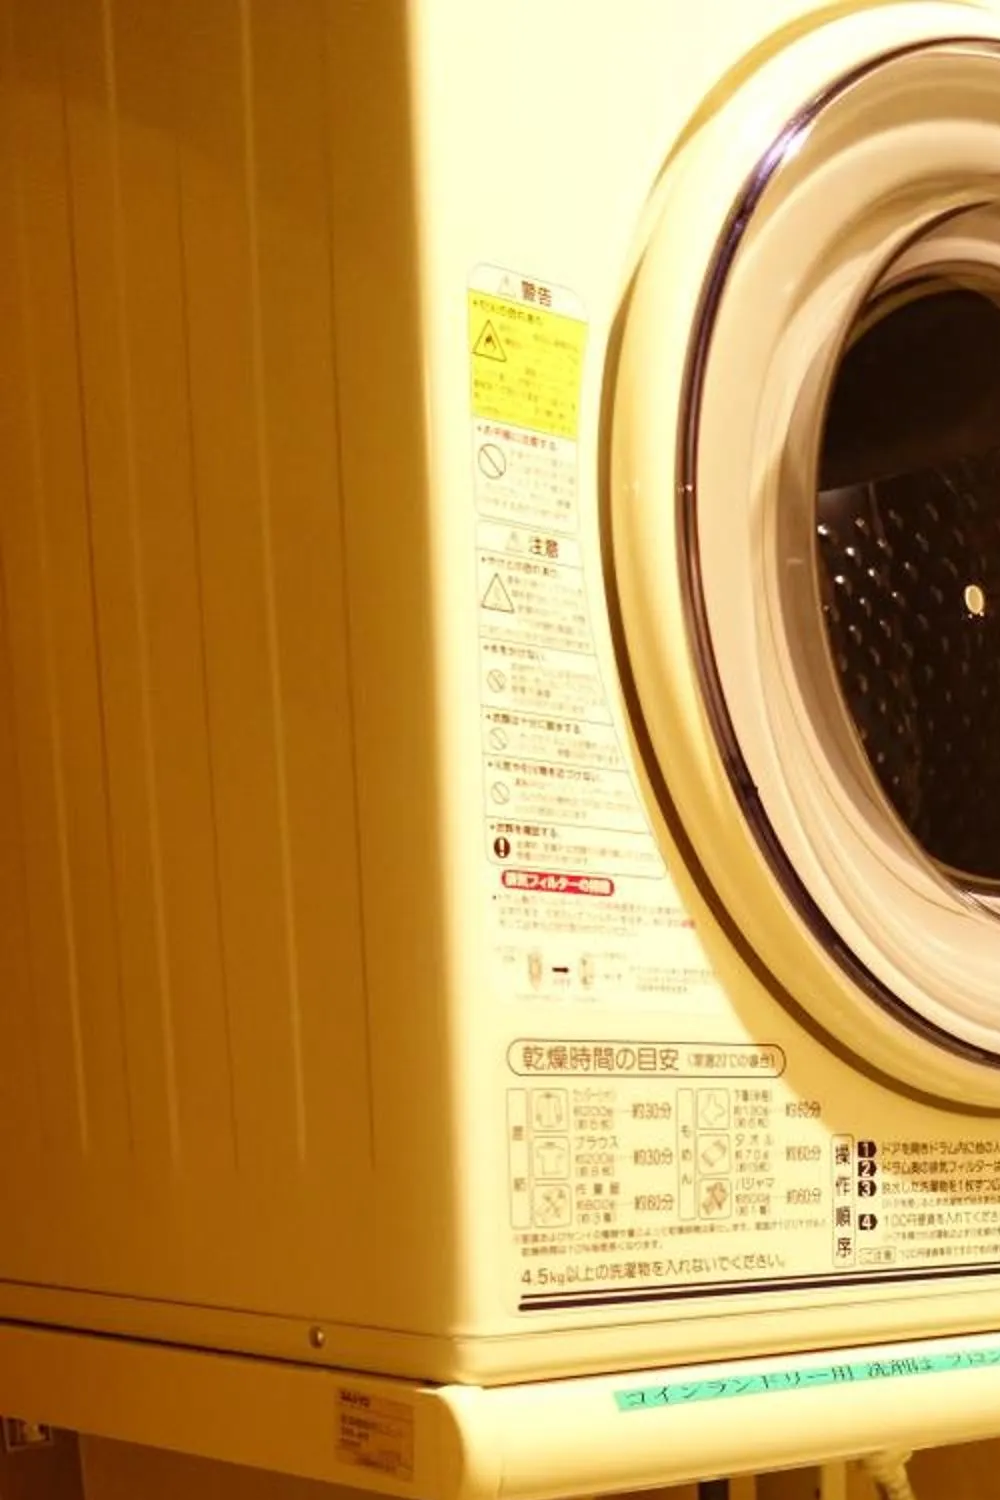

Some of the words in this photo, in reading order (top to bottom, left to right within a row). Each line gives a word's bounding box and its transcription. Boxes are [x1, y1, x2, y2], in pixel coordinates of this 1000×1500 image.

[522, 1046, 680, 1072] 乾燥時間の目安
[575, 1135, 618, 1150] ブラウス
[835, 1142, 852, 1258] 操作順序
[625, 1363, 855, 1407] コインランドリー用
